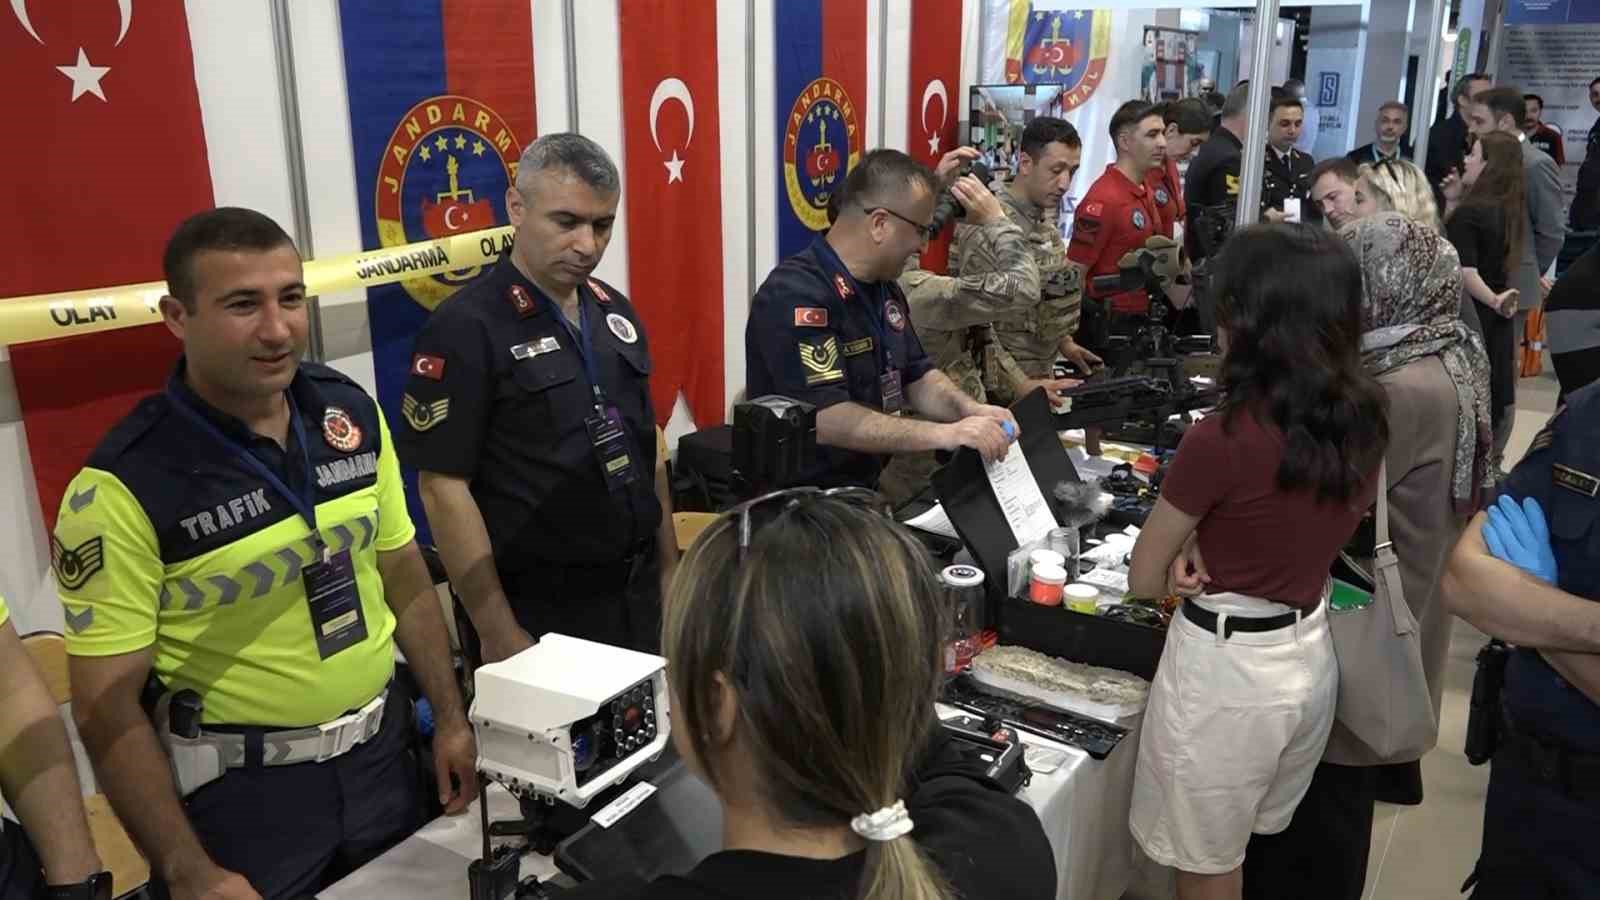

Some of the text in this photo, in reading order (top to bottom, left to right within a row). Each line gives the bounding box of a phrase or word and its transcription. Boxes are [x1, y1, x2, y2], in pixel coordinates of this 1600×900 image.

[788, 83, 856, 146] JANDARMA
[357, 246, 450, 280] JANDARMA
[179, 488, 271, 540] TRAFİK
